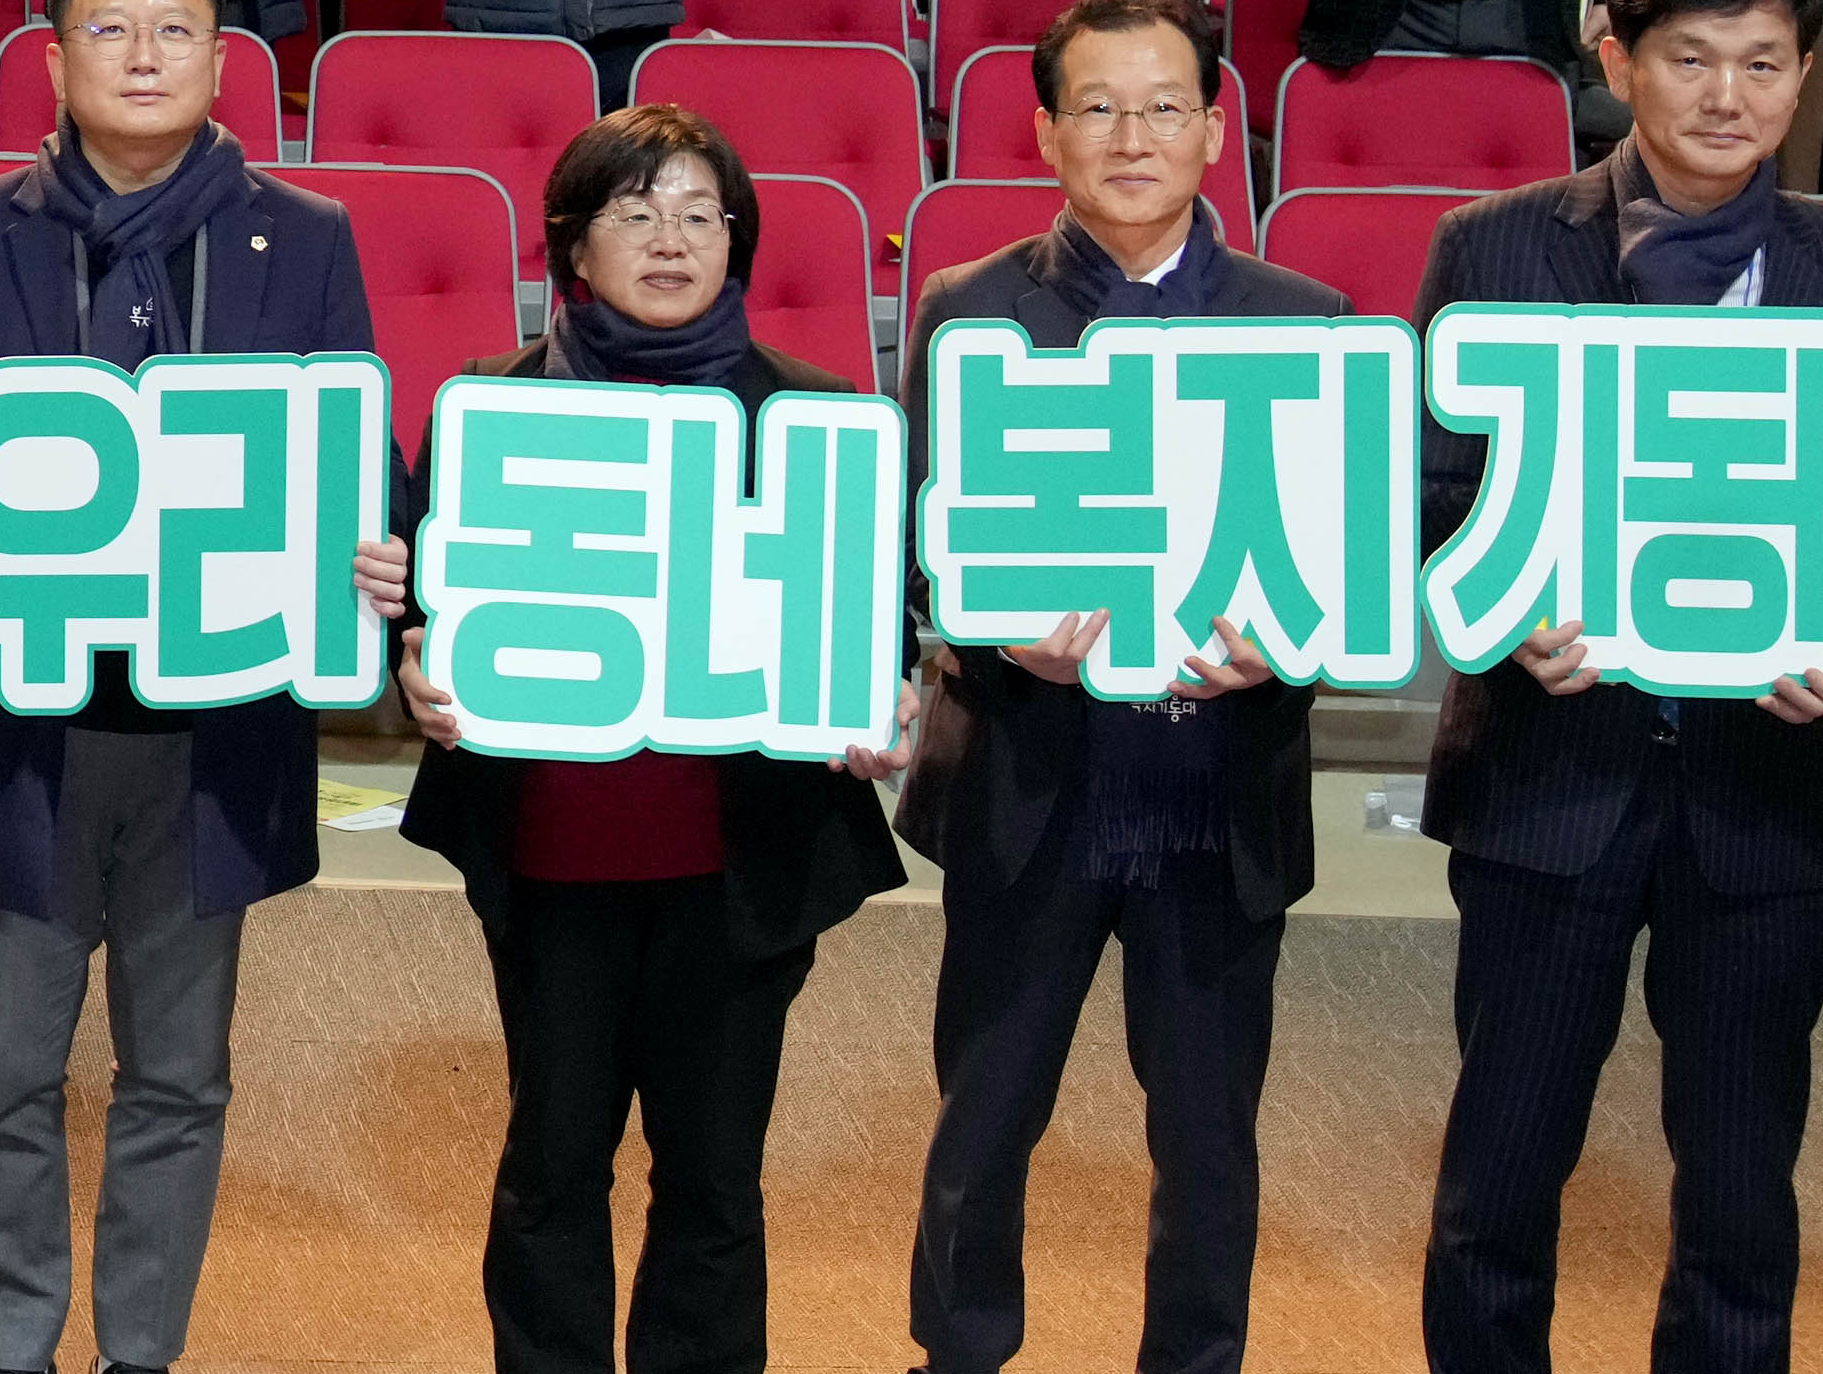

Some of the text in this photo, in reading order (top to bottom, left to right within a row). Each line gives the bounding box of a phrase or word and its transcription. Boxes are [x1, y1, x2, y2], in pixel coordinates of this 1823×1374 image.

[446, 410, 877, 728] 동네
[949, 353, 1390, 668] 복지
[1453, 343, 1823, 656] 기동
